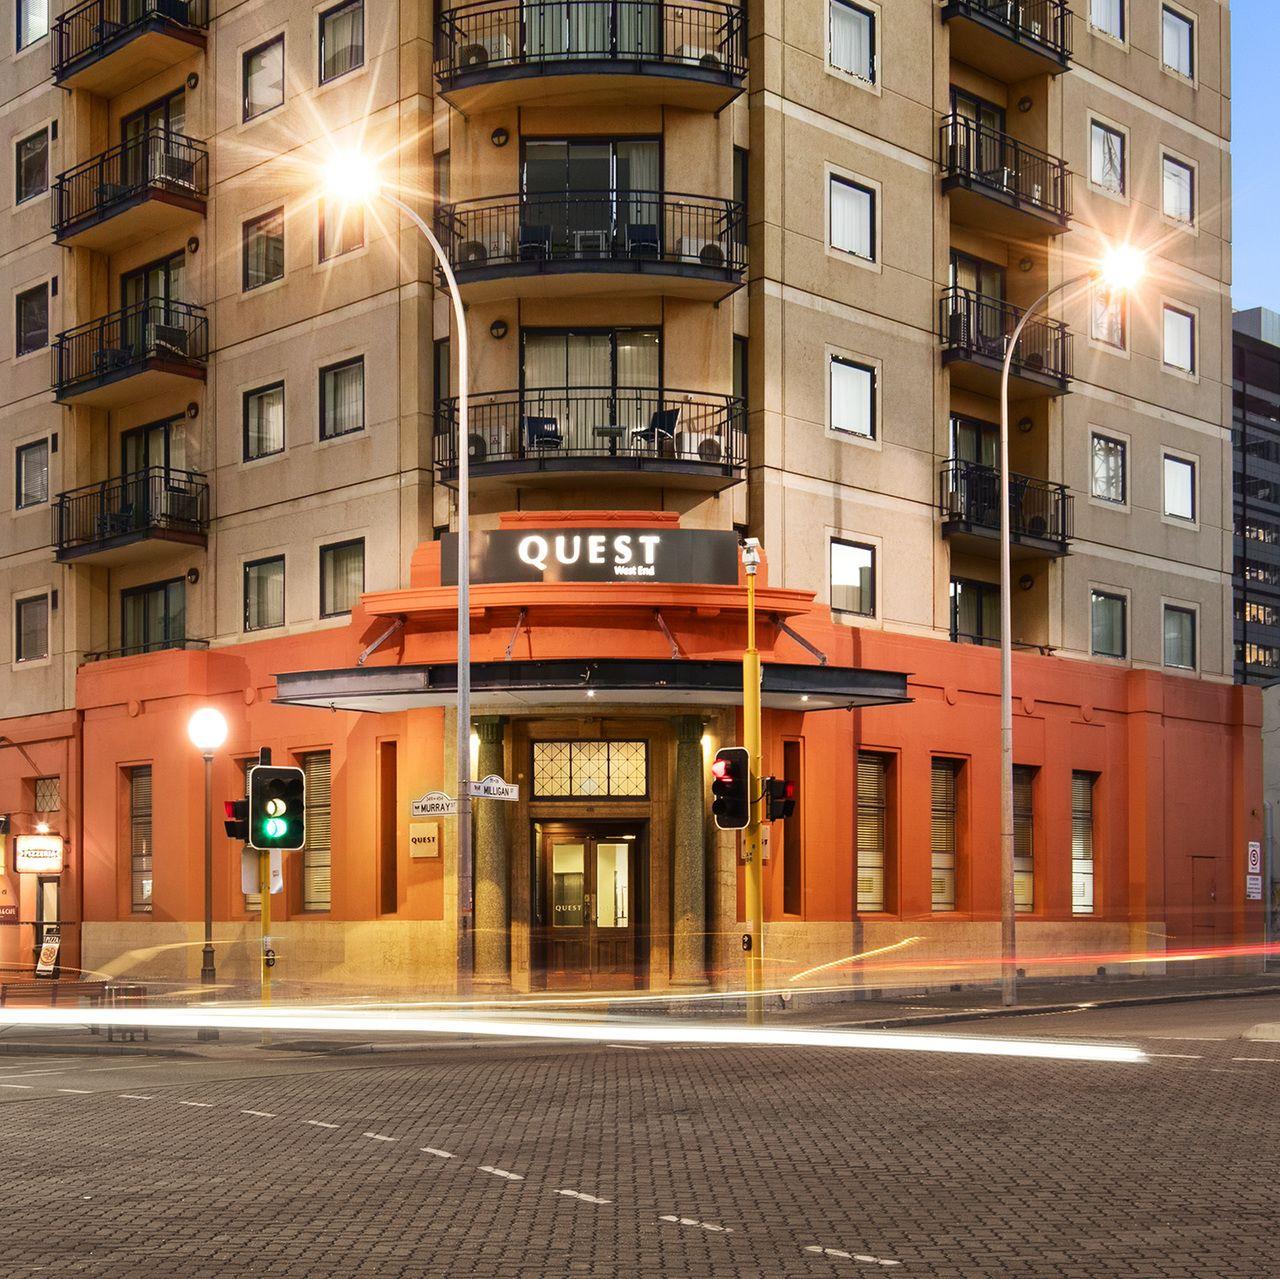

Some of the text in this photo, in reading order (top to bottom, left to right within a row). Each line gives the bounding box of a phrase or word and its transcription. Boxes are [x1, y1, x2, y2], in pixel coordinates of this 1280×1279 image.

[518, 534, 660, 570] QUEST
[614, 565, 656, 576] West End
[483, 785, 510, 796] MILLIGAN
[421, 802, 451, 813] MURRAY
[411, 836, 436, 844] QUEST
